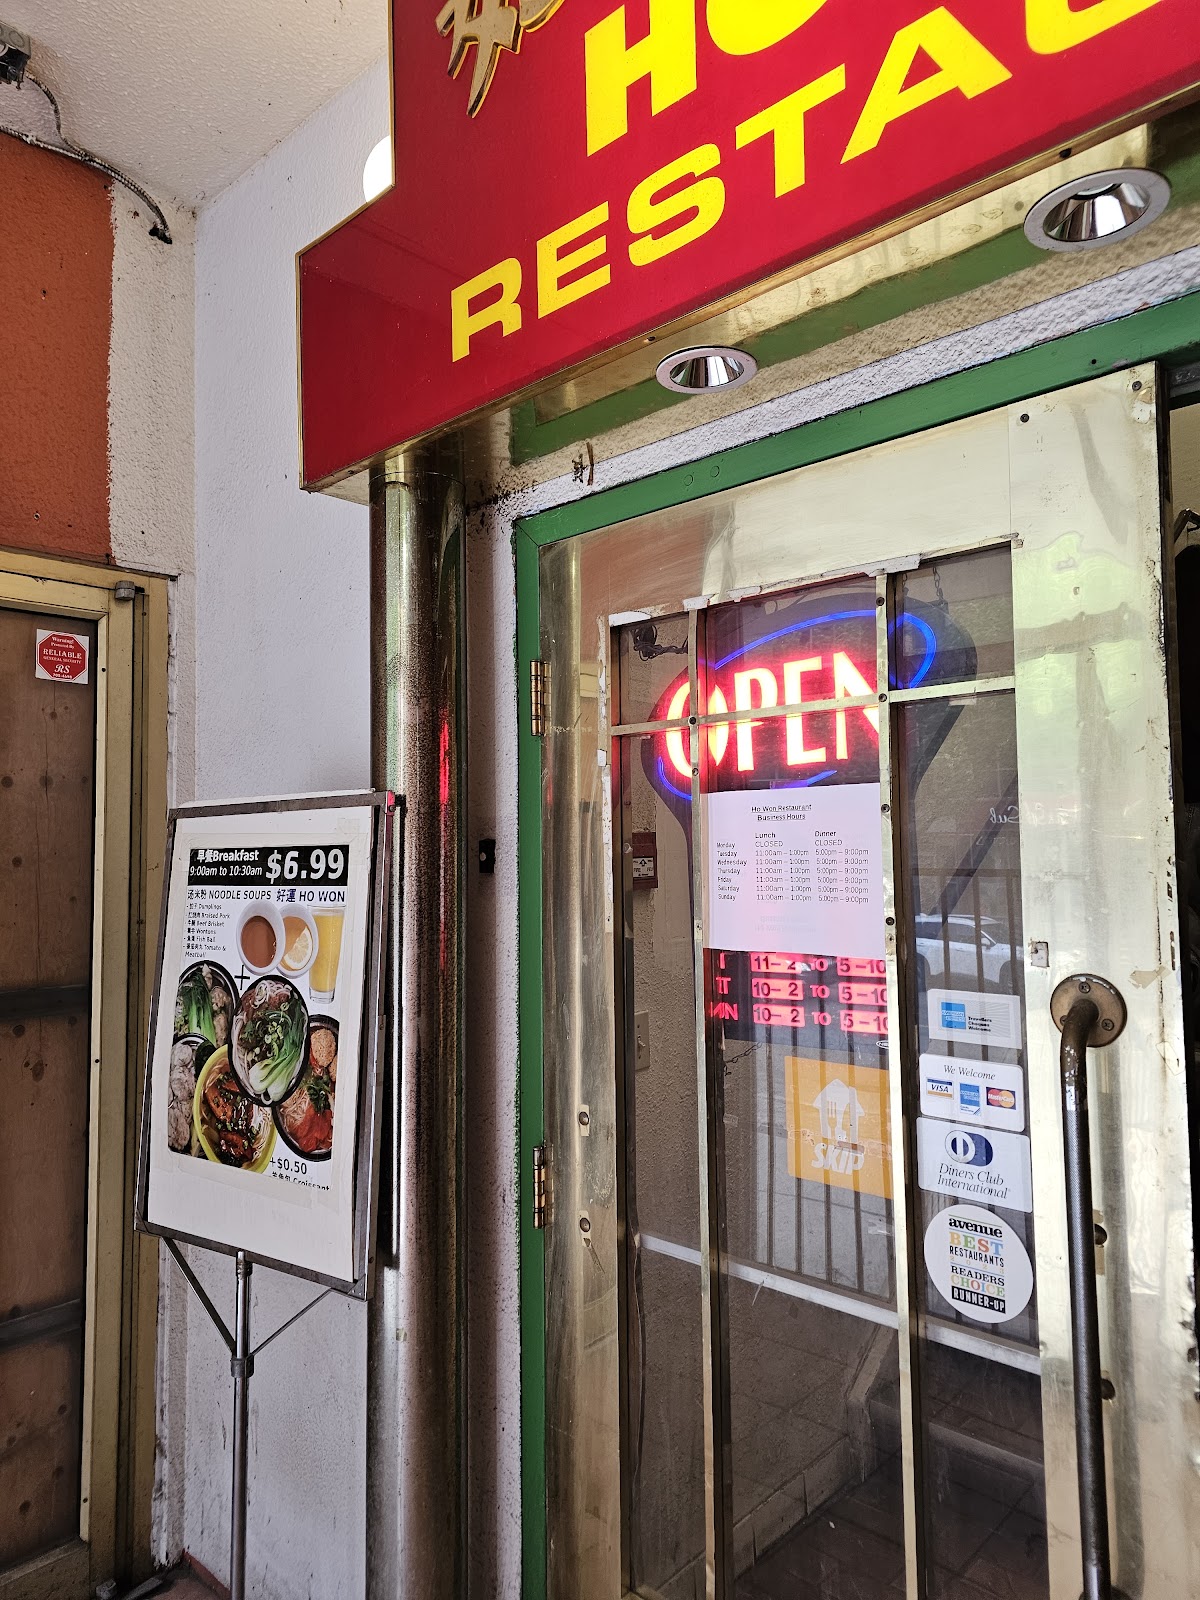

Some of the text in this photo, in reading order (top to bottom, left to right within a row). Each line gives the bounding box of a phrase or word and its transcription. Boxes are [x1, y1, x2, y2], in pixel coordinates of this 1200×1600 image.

[43, 649, 82, 659] RELIABLE
[666, 651, 880, 779] OPEN
[190, 865, 262, 876] 9:00am to 10:30am
[266, 849, 344, 884] $6.99
[209, 890, 241, 899] NOODLE
[244, 890, 271, 899] SOUPS
[277, 889, 345, 902] 好運 HO WON
[810, 985, 830, 998] TO
[812, 1012, 831, 1026] TO
[944, 1065, 996, 1080] We Welcome
[931, 1084, 948, 1093] VISA
[988, 1093, 1014, 1103] MasterCard
[812, 1142, 864, 1176] SKIP
[939, 1163, 1003, 1186] Diners Club
[938, 1175, 1007, 1199] International
[948, 1218, 1002, 1238] avenue
[949, 1232, 1003, 1256] BEST
[950, 1246, 1004, 1268] RESTAURANTS
[951, 1266, 1004, 1286] READERS
[951, 1274, 1005, 1297] CHOICE
[954, 1288, 1004, 1311] RUNNER-UP
